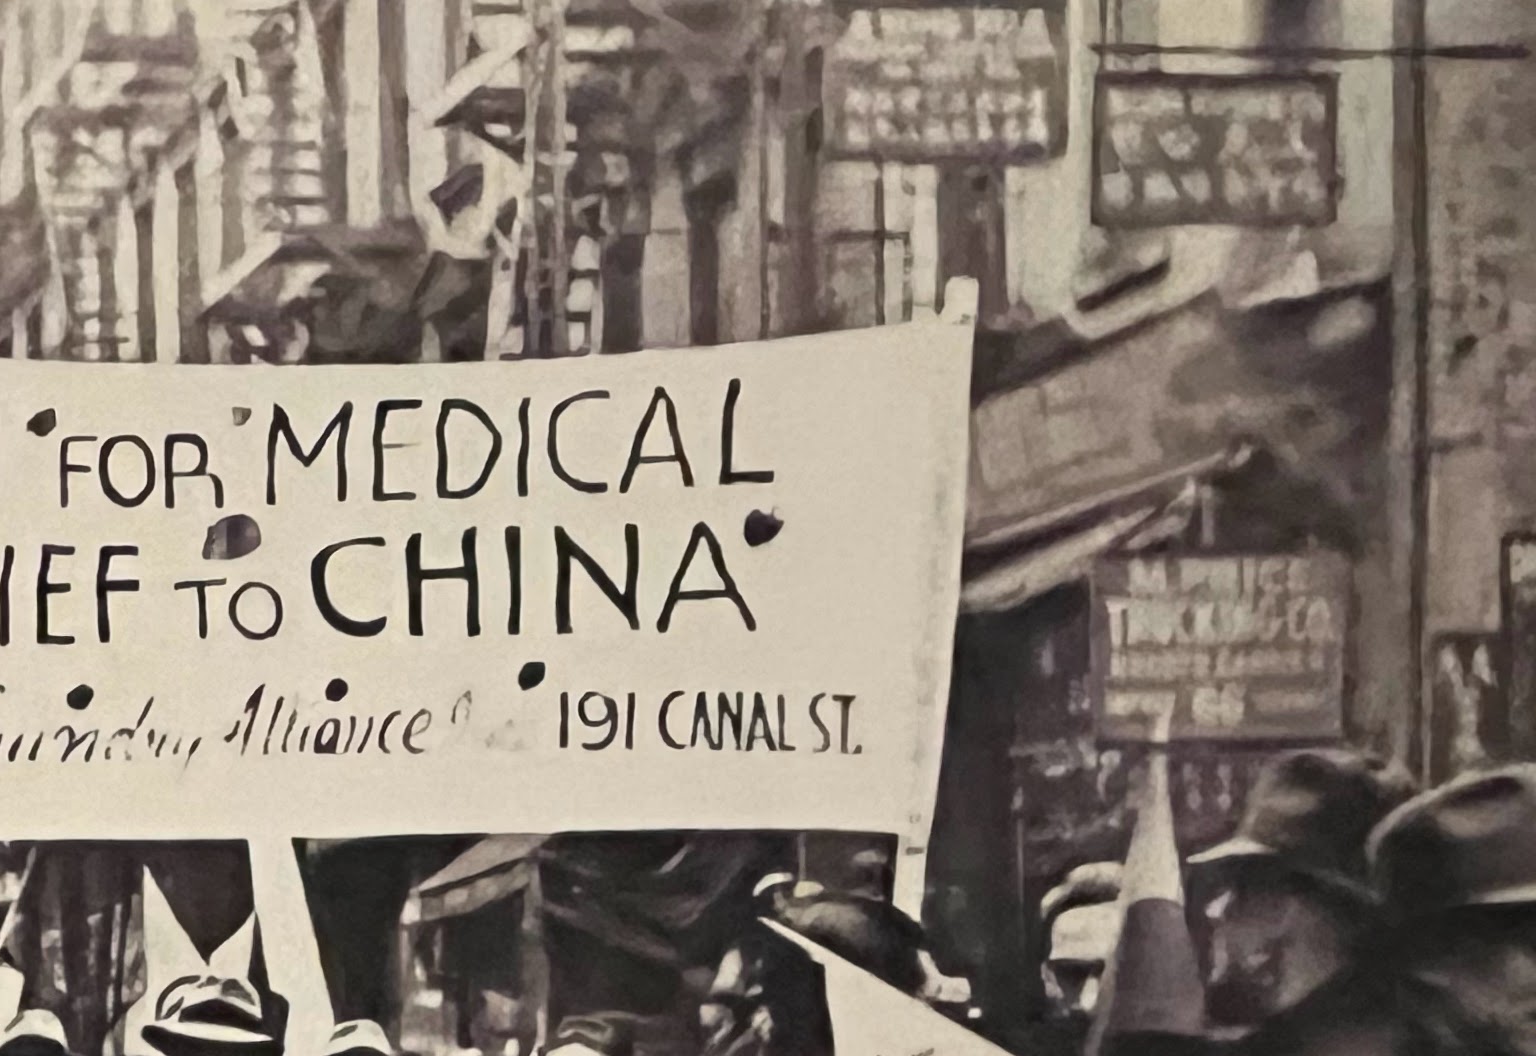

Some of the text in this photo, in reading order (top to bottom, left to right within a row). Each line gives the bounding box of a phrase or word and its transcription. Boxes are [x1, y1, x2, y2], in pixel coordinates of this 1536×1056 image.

[59, 433, 226, 510] FOR
[265, 377, 776, 507] MEDICAL
[173, 577, 285, 642] TO
[309, 520, 758, 639] CHINA
[558, 690, 637, 753] 191
[657, 689, 797, 753] CANAL
[809, 691, 863, 756] ST.
